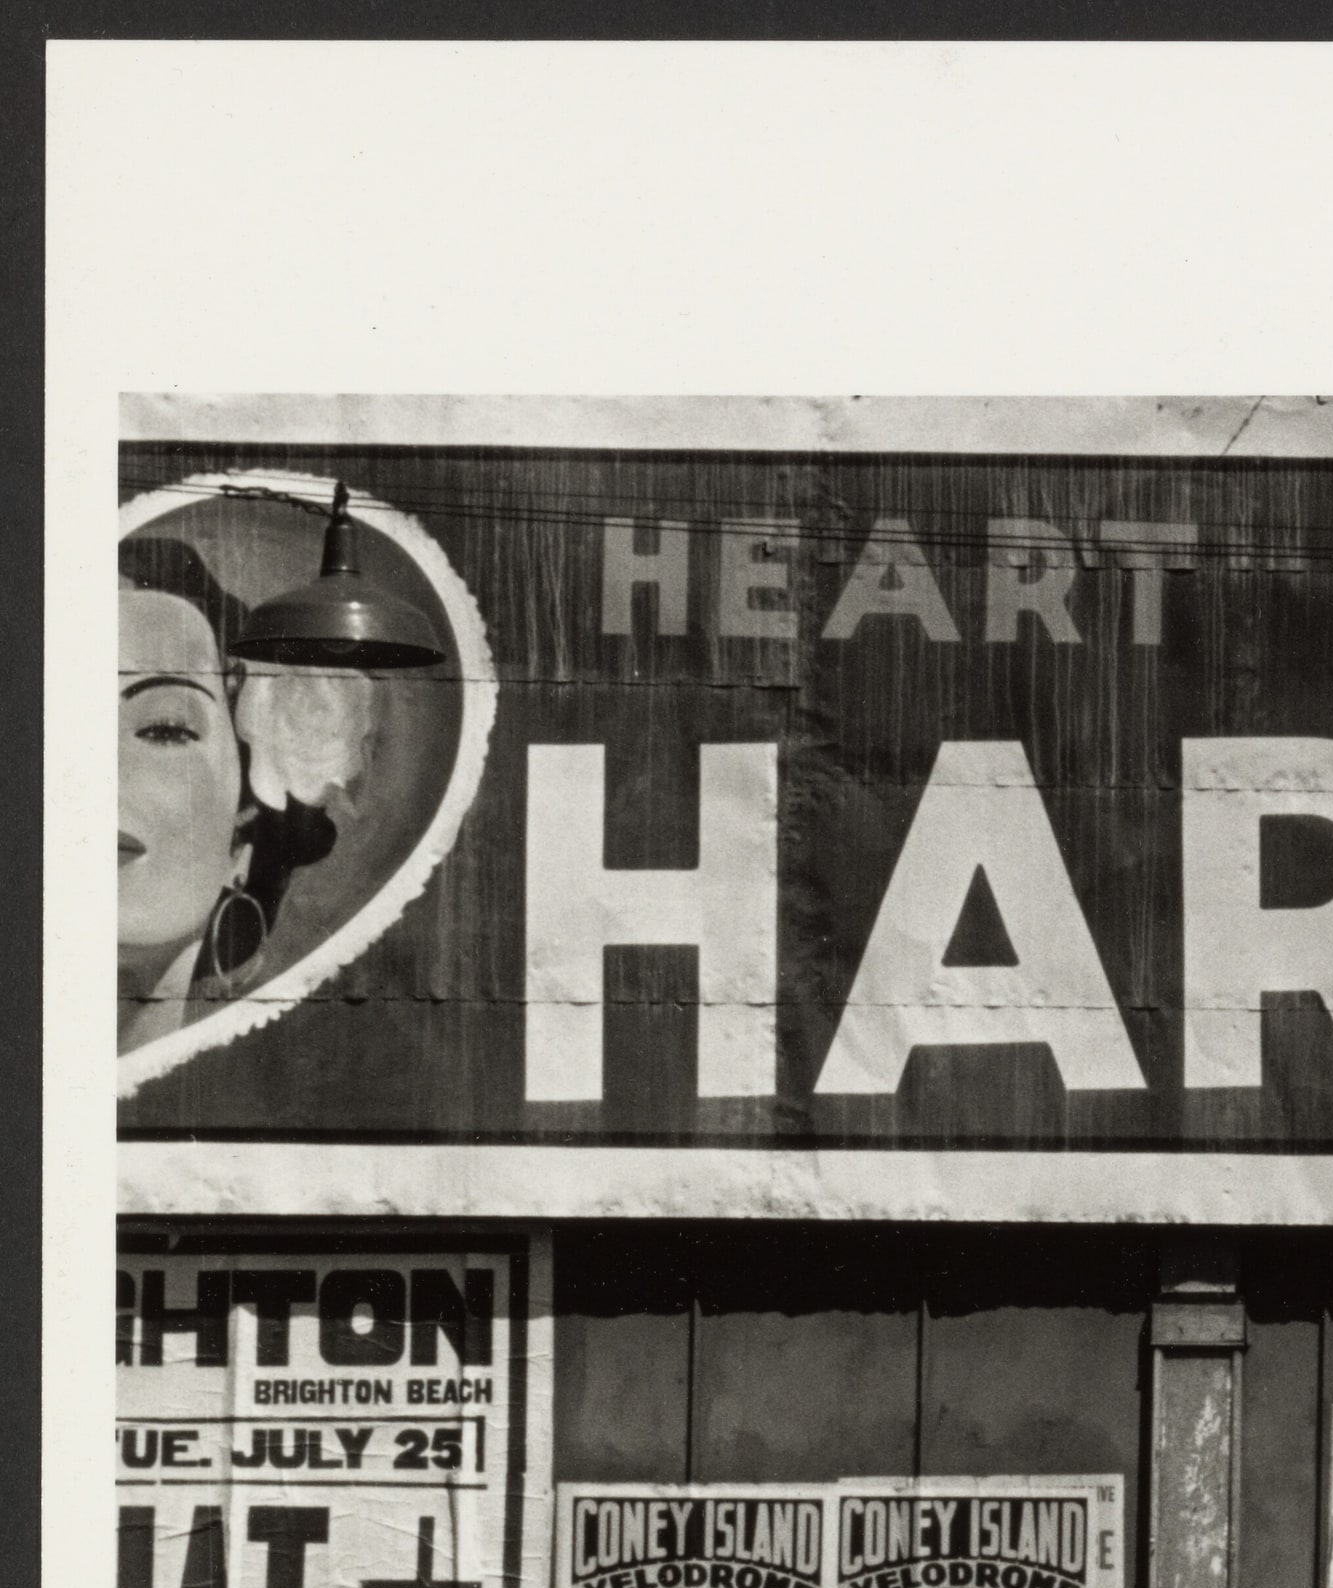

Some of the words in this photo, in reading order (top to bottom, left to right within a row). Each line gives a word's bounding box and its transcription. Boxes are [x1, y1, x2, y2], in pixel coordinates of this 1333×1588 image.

[600, 516, 1200, 645] HEART
[115, 1269, 493, 1368] HTON
[254, 1378, 392, 1406] BRIGHTON
[406, 1378, 493, 1405] BEACH
[115, 1429, 212, 1470] UE.
[230, 1428, 374, 1471] JULY
[392, 1427, 464, 1470] 25
[575, 1499, 693, 1577] CONEY
[704, 1499, 820, 1576] ISLAND
[841, 1499, 958, 1576] CONEY
[970, 1499, 1085, 1574] ISLAND
